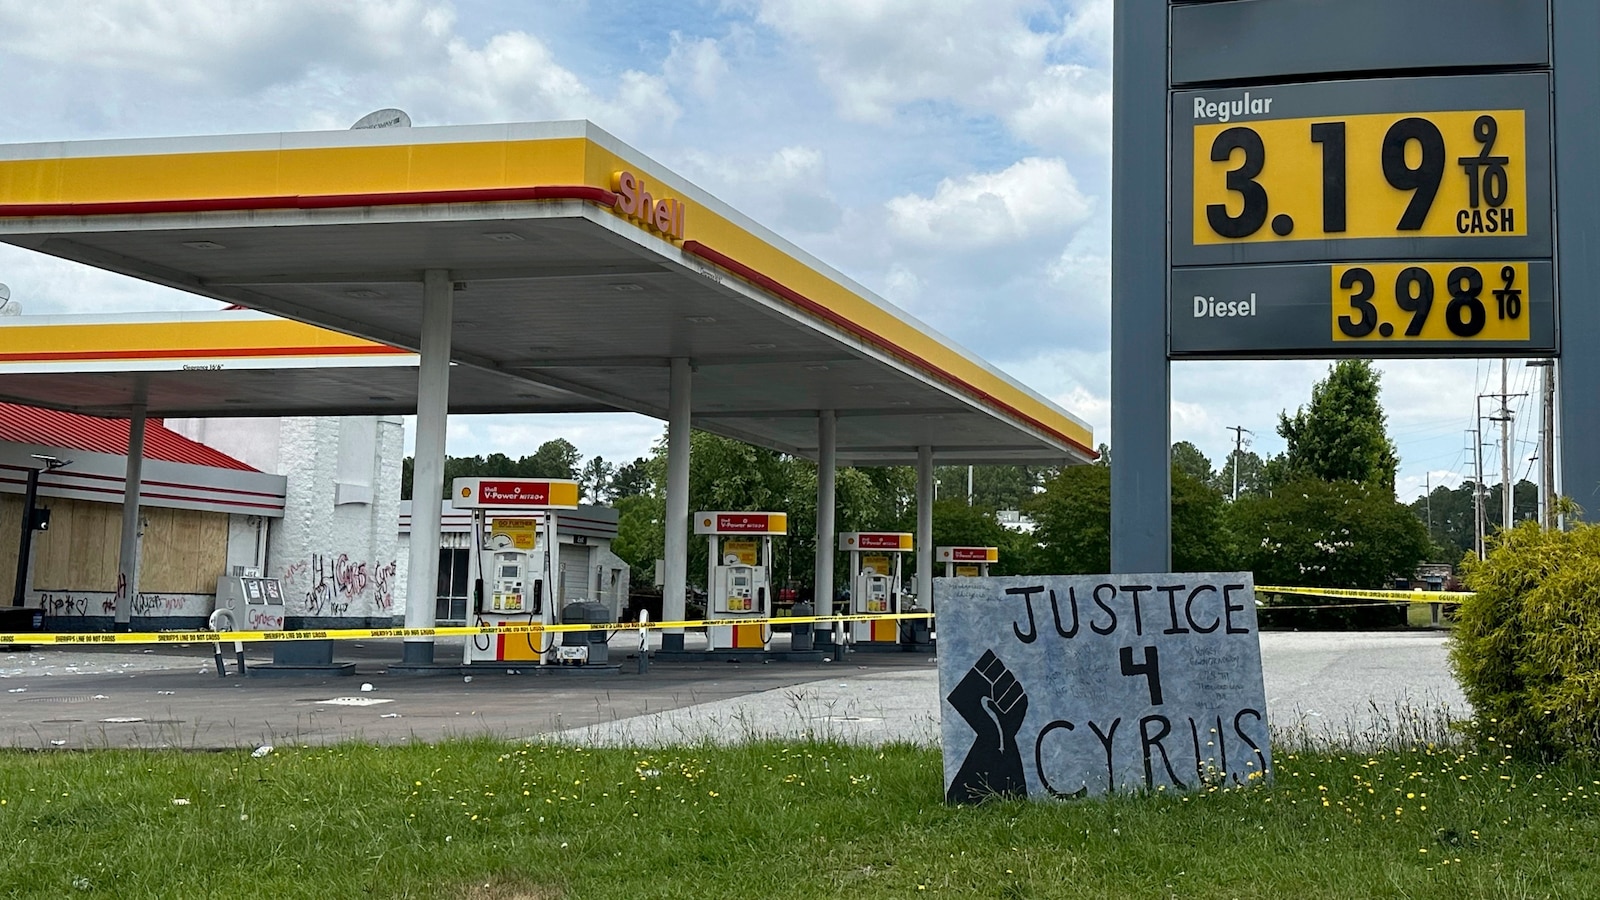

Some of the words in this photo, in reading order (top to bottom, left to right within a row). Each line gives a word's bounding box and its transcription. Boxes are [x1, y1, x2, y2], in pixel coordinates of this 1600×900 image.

[1193, 92, 1273, 122] Regular
[613, 171, 685, 240] Shell
[1206, 117, 1446, 239] 3.19
[1456, 208, 1514, 233] CASH
[1193, 293, 1256, 317] Diesel
[1338, 266, 1486, 337] 3.98
[1005, 583, 1250, 644] JUSTICE
[1119, 646, 1164, 705] 4
[1035, 708, 1268, 799] CYRUS
